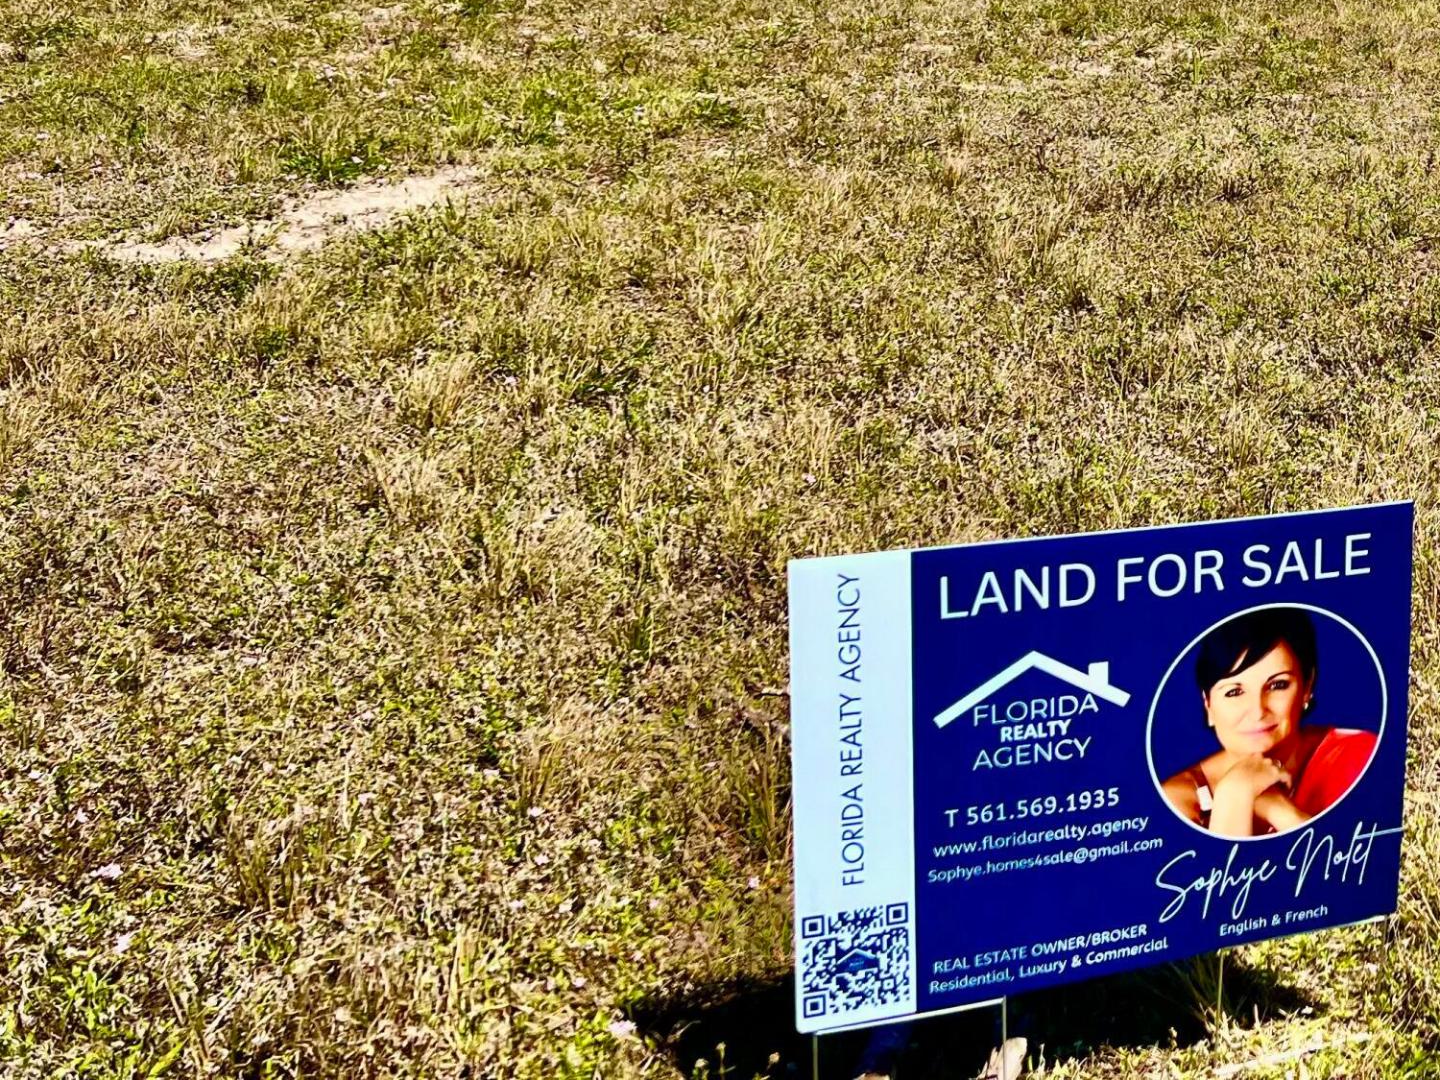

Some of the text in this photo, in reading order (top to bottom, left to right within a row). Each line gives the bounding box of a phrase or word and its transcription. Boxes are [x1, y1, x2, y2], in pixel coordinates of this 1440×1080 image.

[939, 532, 1373, 619] LAND FOR SALE
[837, 572, 864, 887] FLORIDA REALTY AGENCY
[973, 692, 1099, 728] FLORIDA
[1000, 717, 1072, 744] REALTY
[972, 735, 1092, 772] AGENCY
[944, 787, 1120, 828] T 561.569.1935
[933, 816, 1149, 858] www.floridarealty.agency
[927, 837, 1164, 883] Sophye.homes4sale@gmail.com
[1154, 843, 1277, 924] Sophye
[1219, 904, 1328, 937] English & French
[929, 936, 1169, 994] Residential, Luxury & Commercial
[933, 923, 1148, 974] REAL ESTATE OWNER/BROKER
